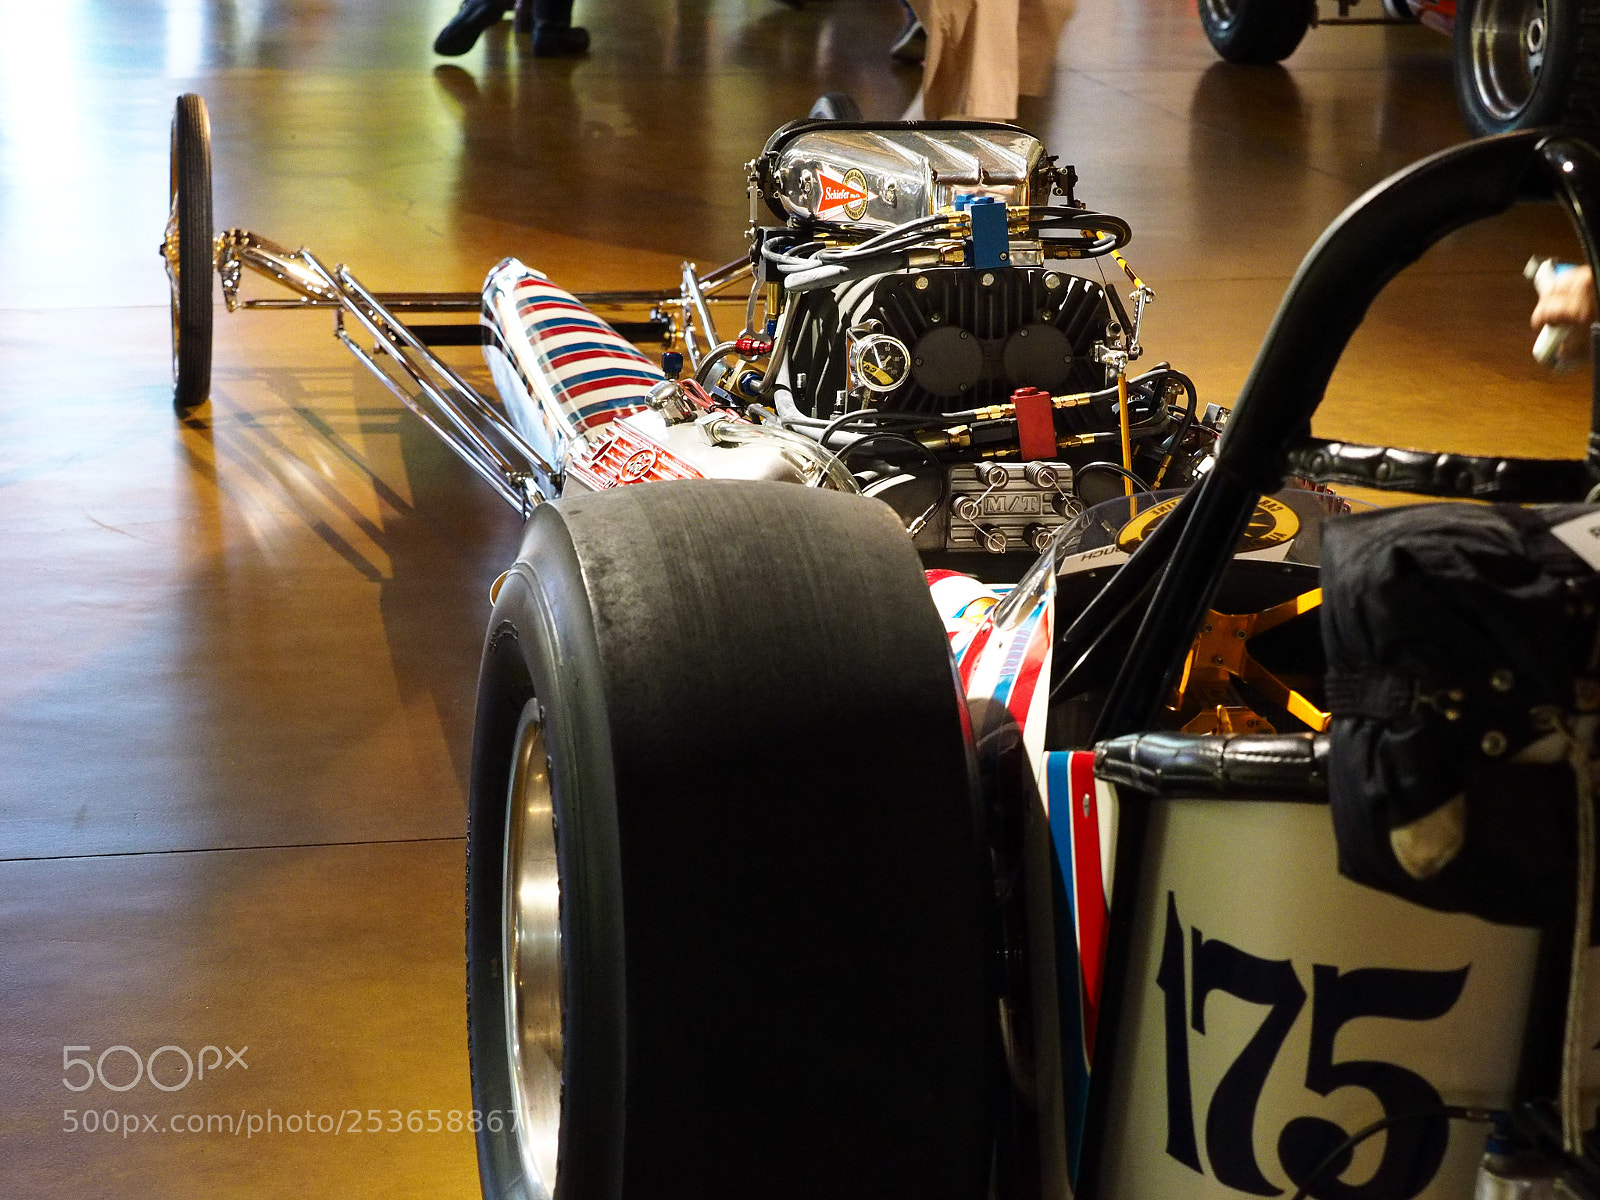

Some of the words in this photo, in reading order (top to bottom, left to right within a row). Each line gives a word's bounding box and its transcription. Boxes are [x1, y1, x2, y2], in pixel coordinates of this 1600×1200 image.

[825, 187, 850, 200] Schiefer
[986, 495, 1038, 513] M/T
[1156, 889, 1471, 1200] 175
